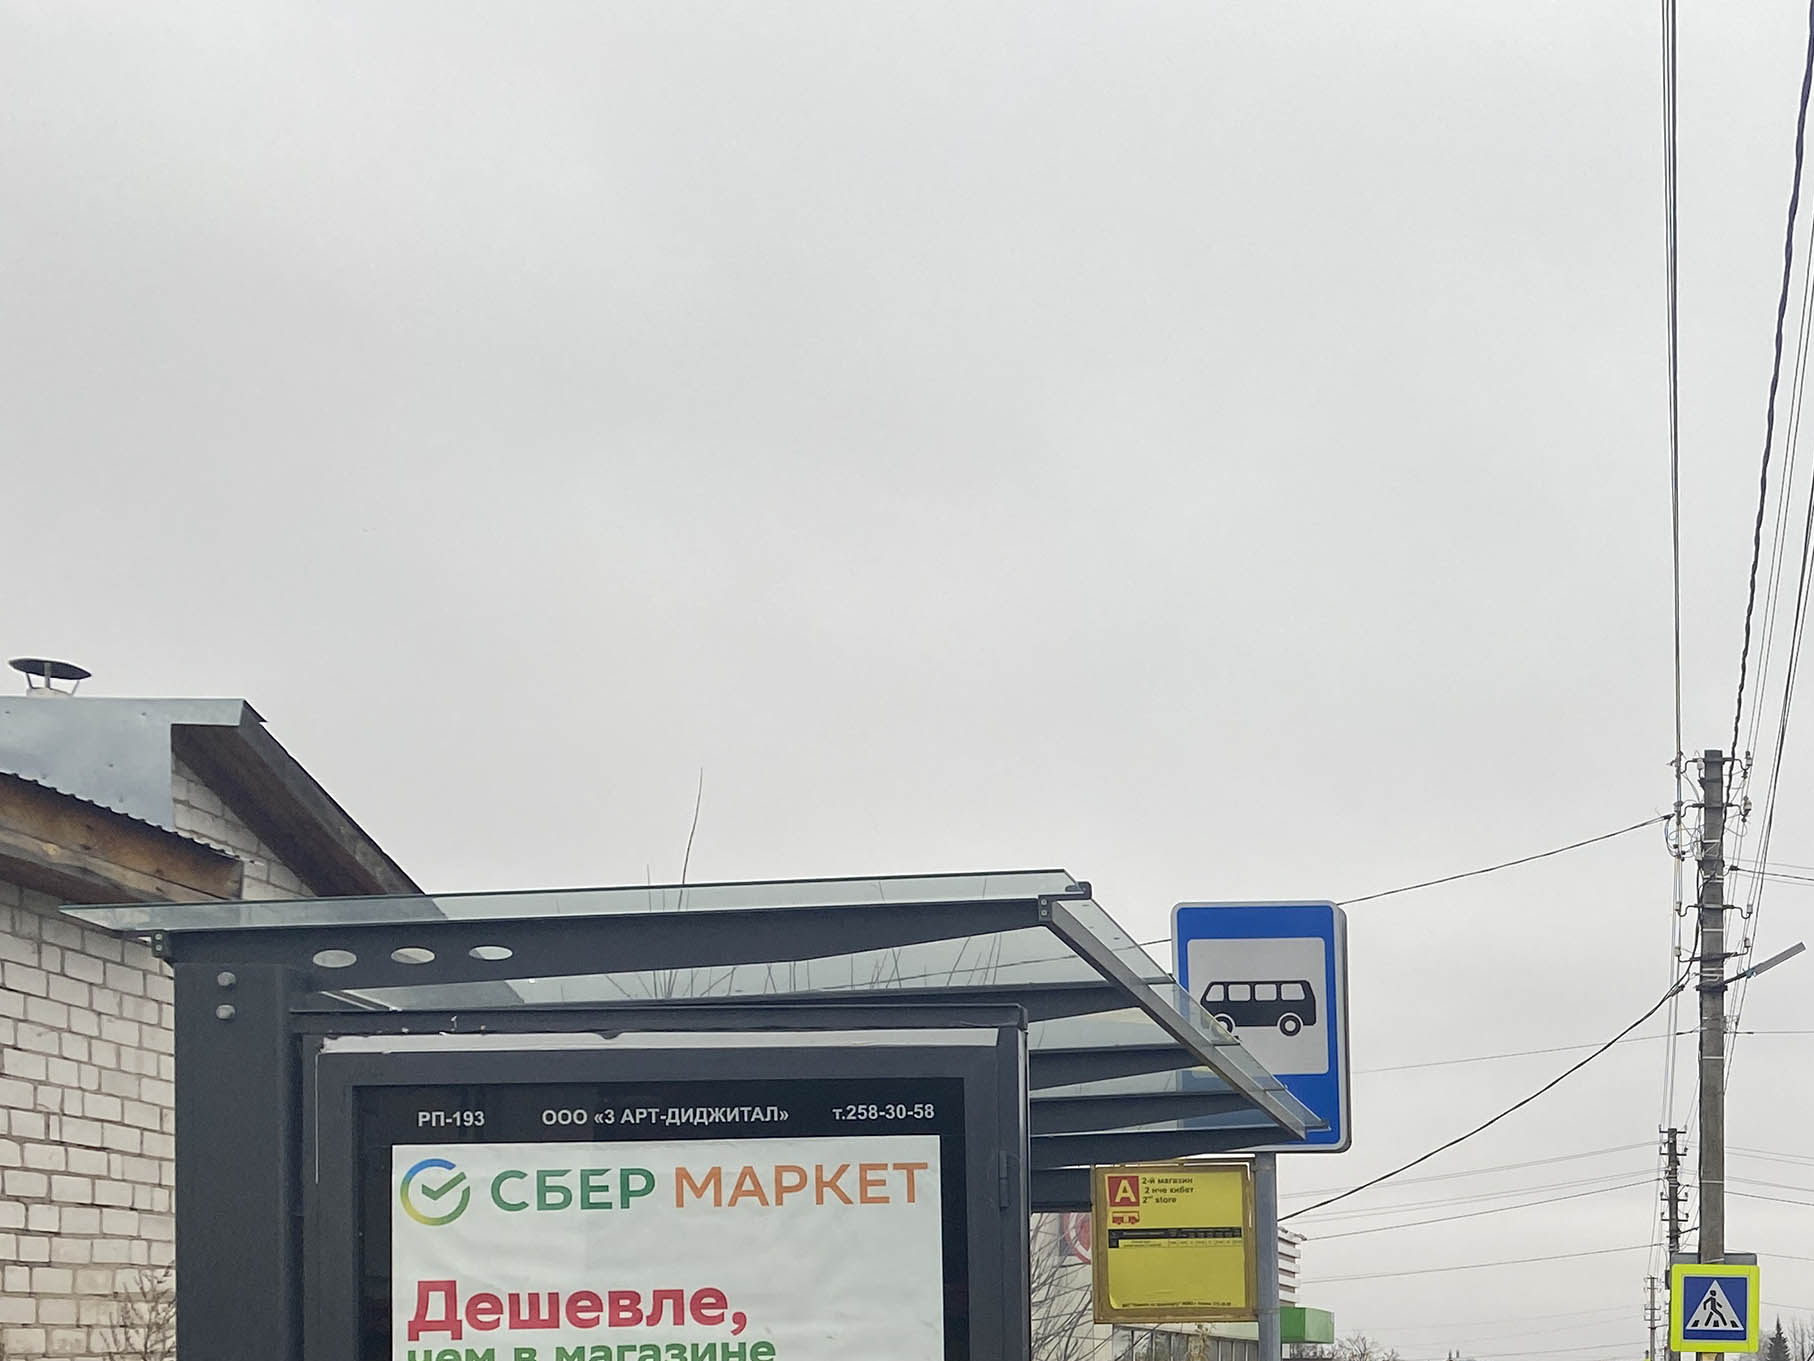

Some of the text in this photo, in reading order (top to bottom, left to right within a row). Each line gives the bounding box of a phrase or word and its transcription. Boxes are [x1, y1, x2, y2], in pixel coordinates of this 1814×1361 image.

[418, 1110, 485, 1127] РП-193
[542, 1109, 587, 1125] ООО
[620, 1106, 789, 1125] АРТ-ДИДЖИТАЛ»
[832, 1104, 935, 1120] т.258-30-58
[490, 1162, 928, 1212] СБЕР МАРКЕТ
[407, 1280, 748, 1342] Дешевле,
